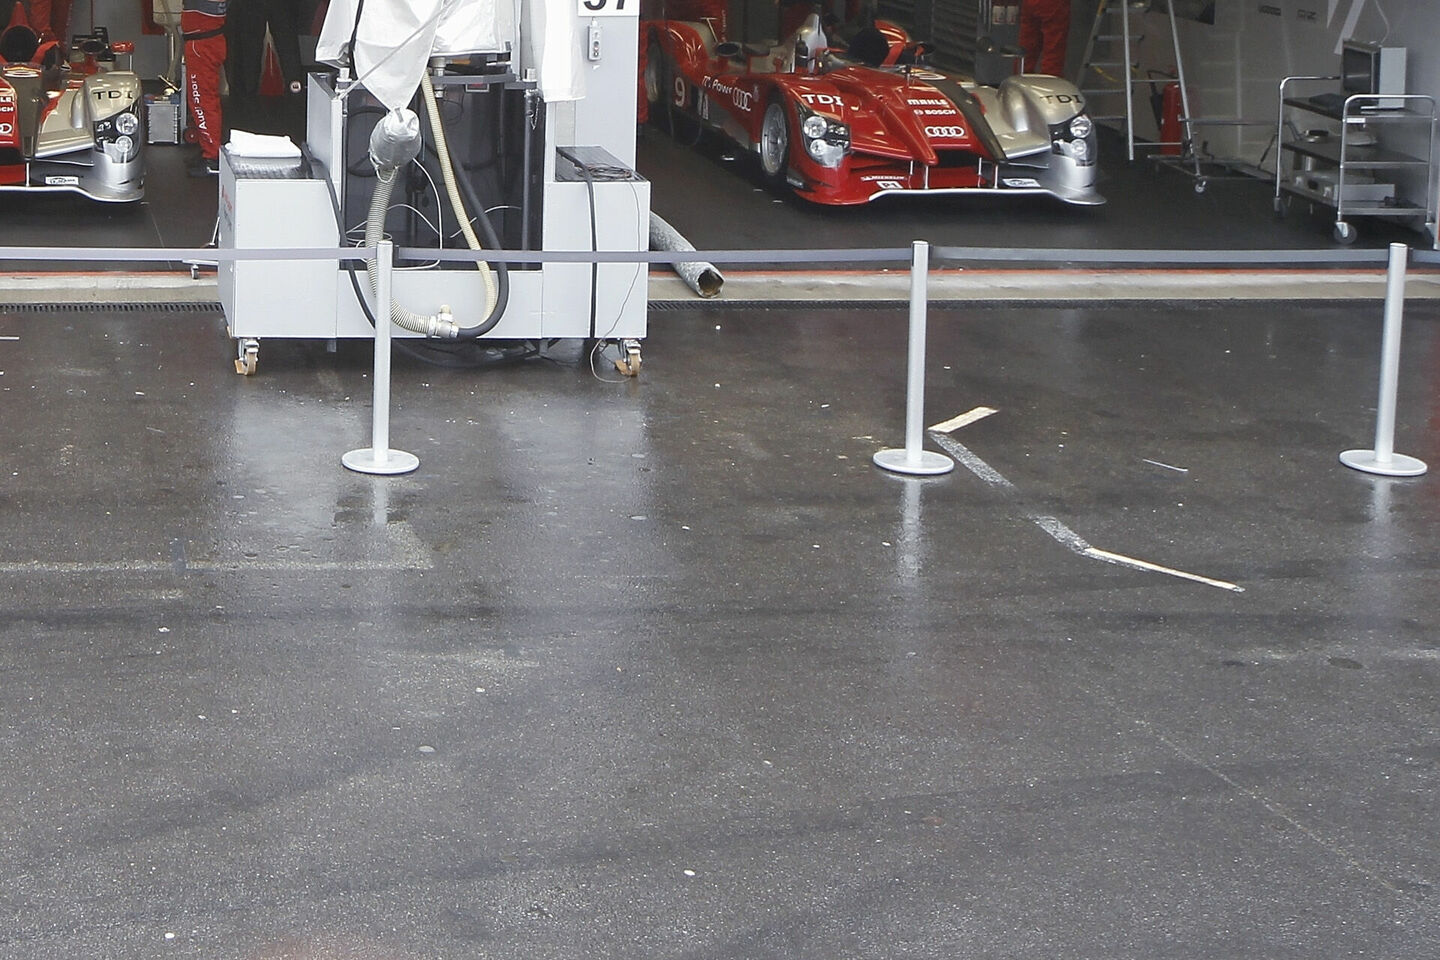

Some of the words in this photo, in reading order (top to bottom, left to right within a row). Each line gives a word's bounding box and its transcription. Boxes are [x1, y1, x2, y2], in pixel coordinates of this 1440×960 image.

[93, 90, 133, 100] TDI
[675, 77, 686, 107] 9
[801, 94, 844, 106] TDI
[1040, 94, 1083, 105] TDI
